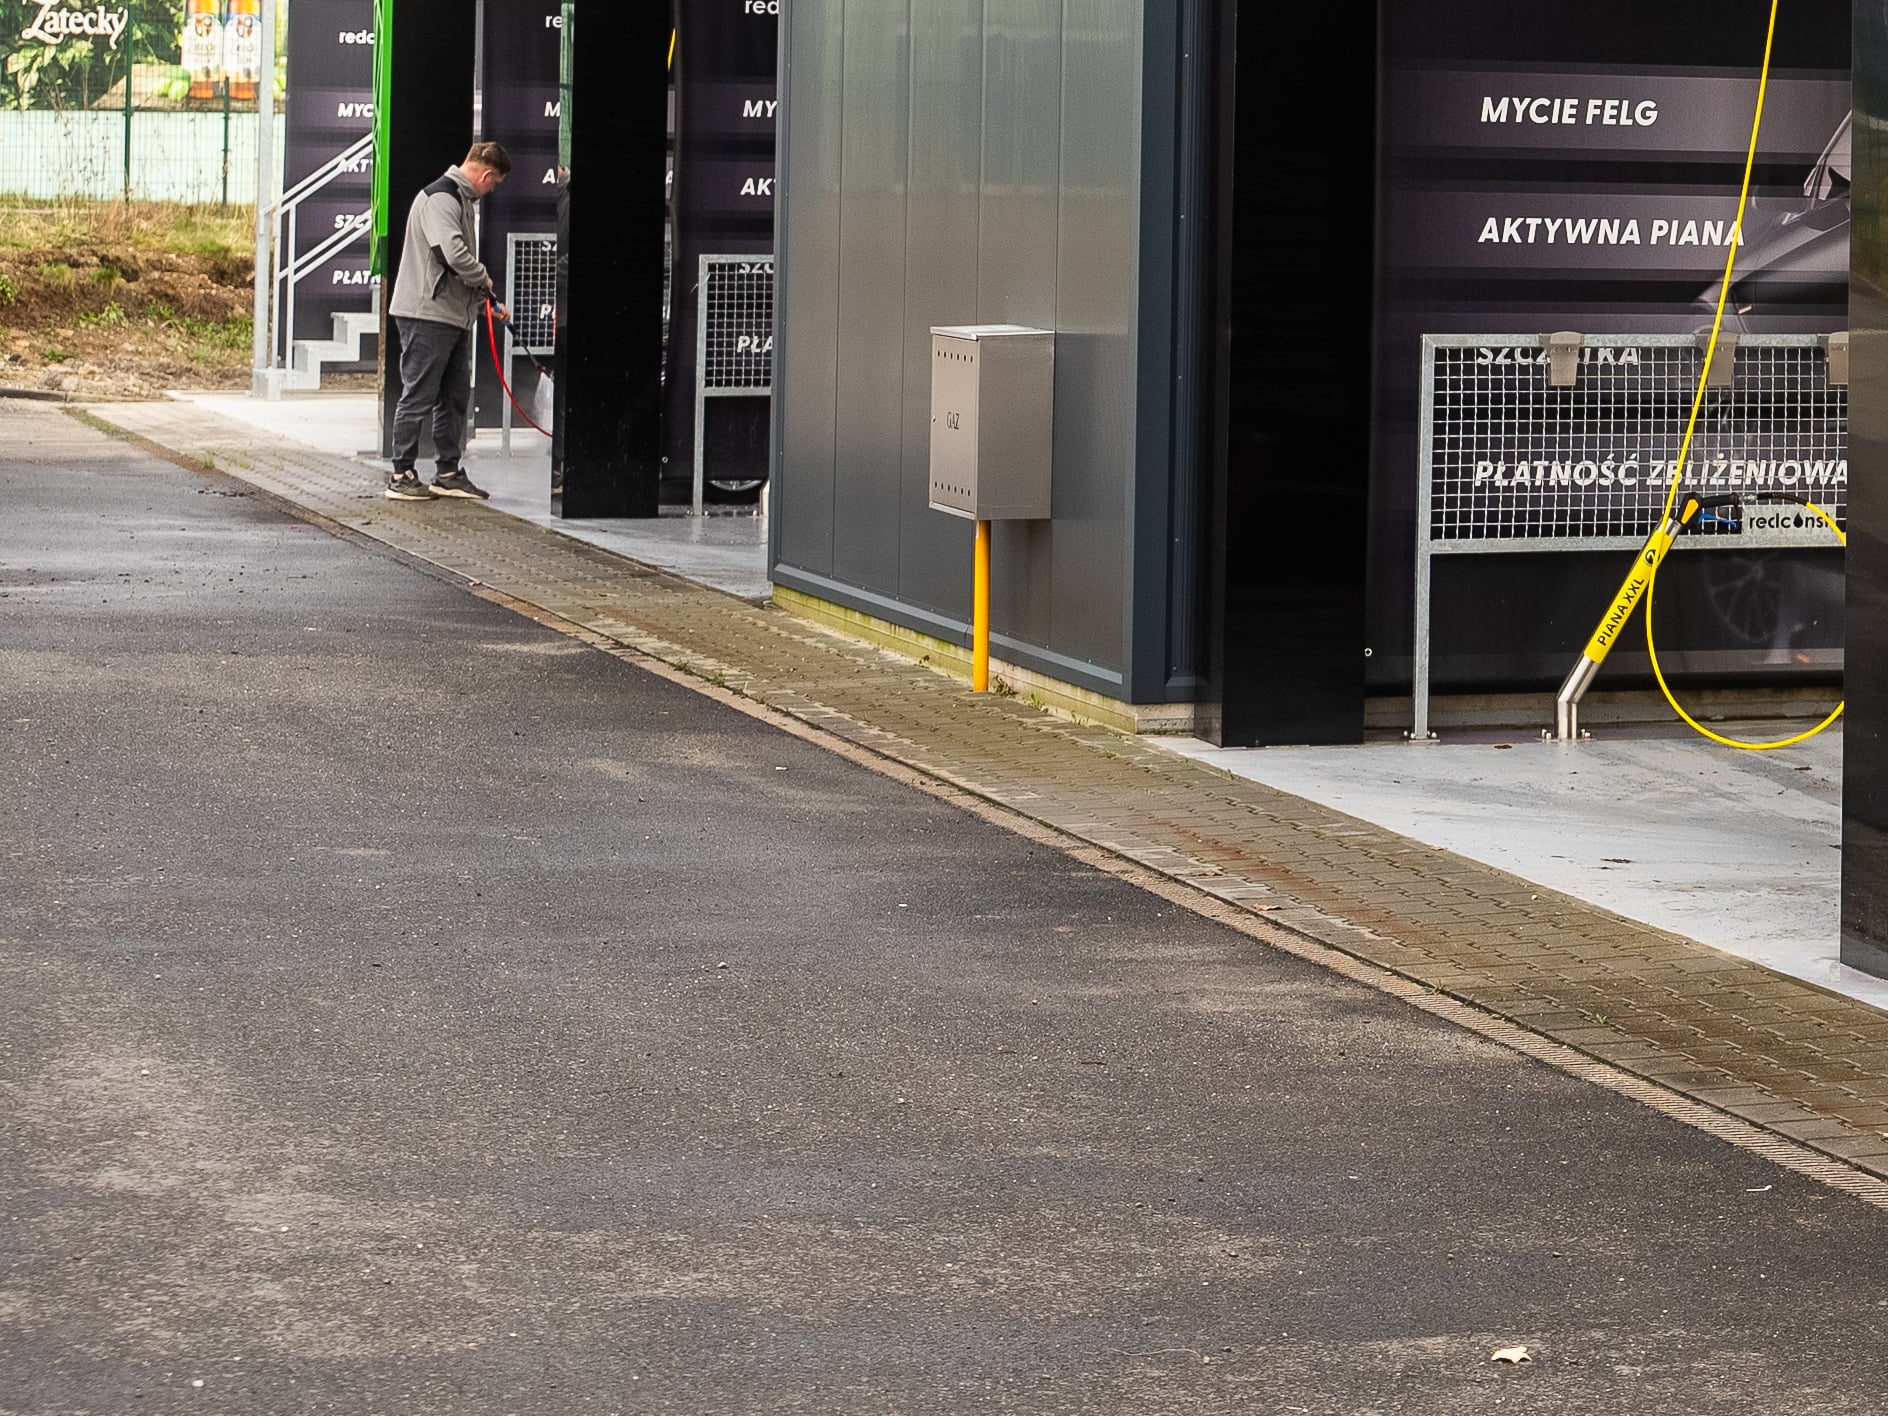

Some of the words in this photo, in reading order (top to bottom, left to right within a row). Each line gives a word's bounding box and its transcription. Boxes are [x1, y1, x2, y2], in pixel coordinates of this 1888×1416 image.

[1480, 96, 1579, 124] MYCIE
[1586, 98, 1659, 126] FELG
[1477, 217, 1642, 244] AKTYWNA
[1650, 219, 1746, 247] PIANA
[946, 411, 960, 430] GAZ
[1474, 453, 1639, 487] PŁATNOŚĆ
[1646, 452, 1849, 486] ZBLIŻENIOWA
[1597, 604, 1629, 647] PIANA
[1623, 578, 1645, 604] XXL
